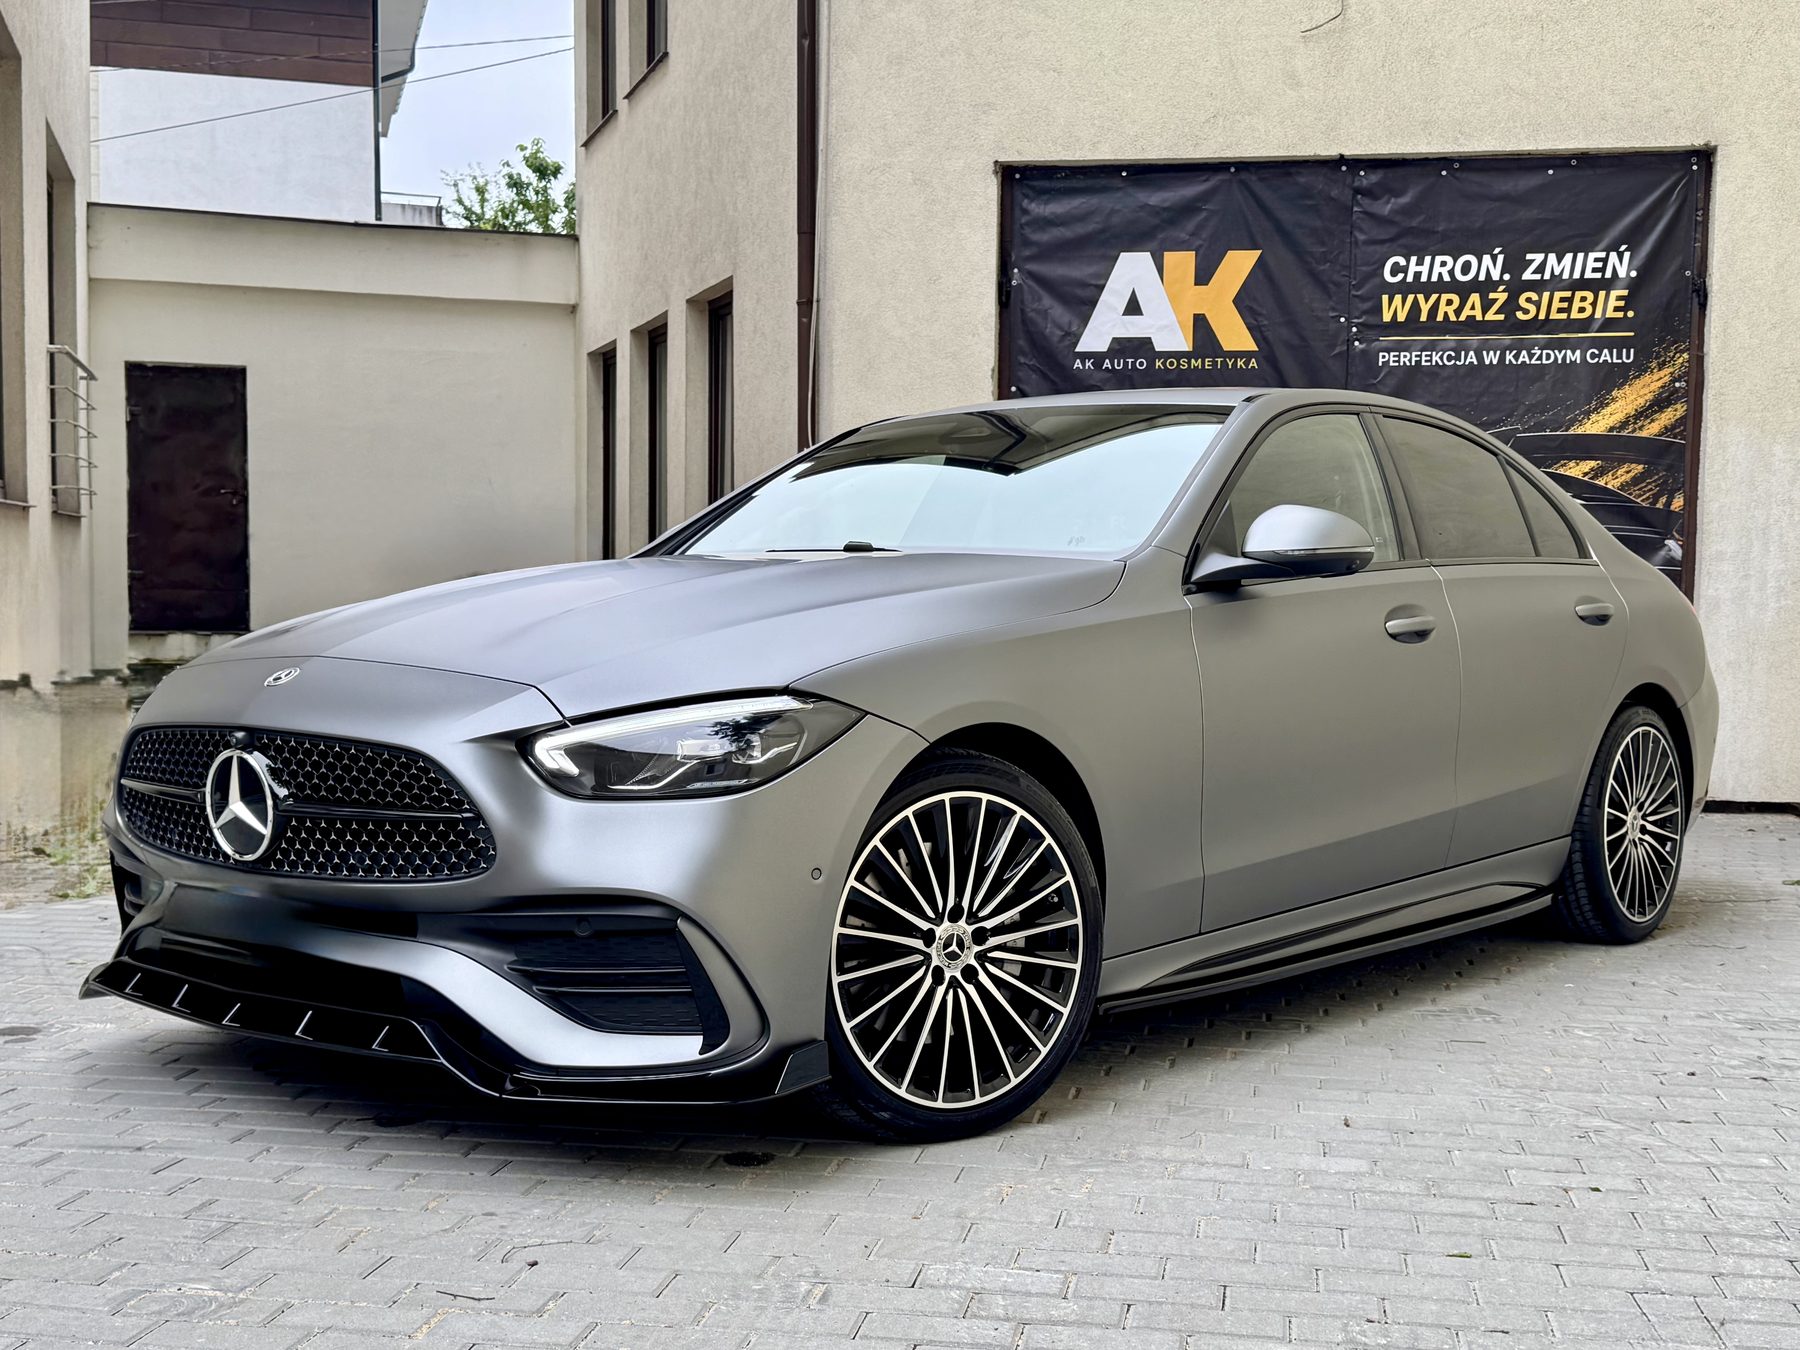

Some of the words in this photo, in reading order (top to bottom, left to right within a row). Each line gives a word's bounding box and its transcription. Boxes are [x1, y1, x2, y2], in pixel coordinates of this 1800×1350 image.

[1383, 248, 1511, 282] CHROŃ.
[1521, 245, 1638, 280] ZMIEŃ.
[1074, 250, 1263, 352] AK
[1381, 286, 1509, 322] WYRAŹ
[1515, 289, 1635, 320] SIEBIE.
[1073, 358, 1096, 370] AK
[1102, 358, 1147, 370] AUTO
[1155, 358, 1259, 370] KOSMETYKA
[1378, 350, 1478, 366] PERFEKCJA
[1482, 350, 1501, 365] W
[1505, 346, 1581, 365] KAŻDYM
[1586, 348, 1635, 363] CALU
